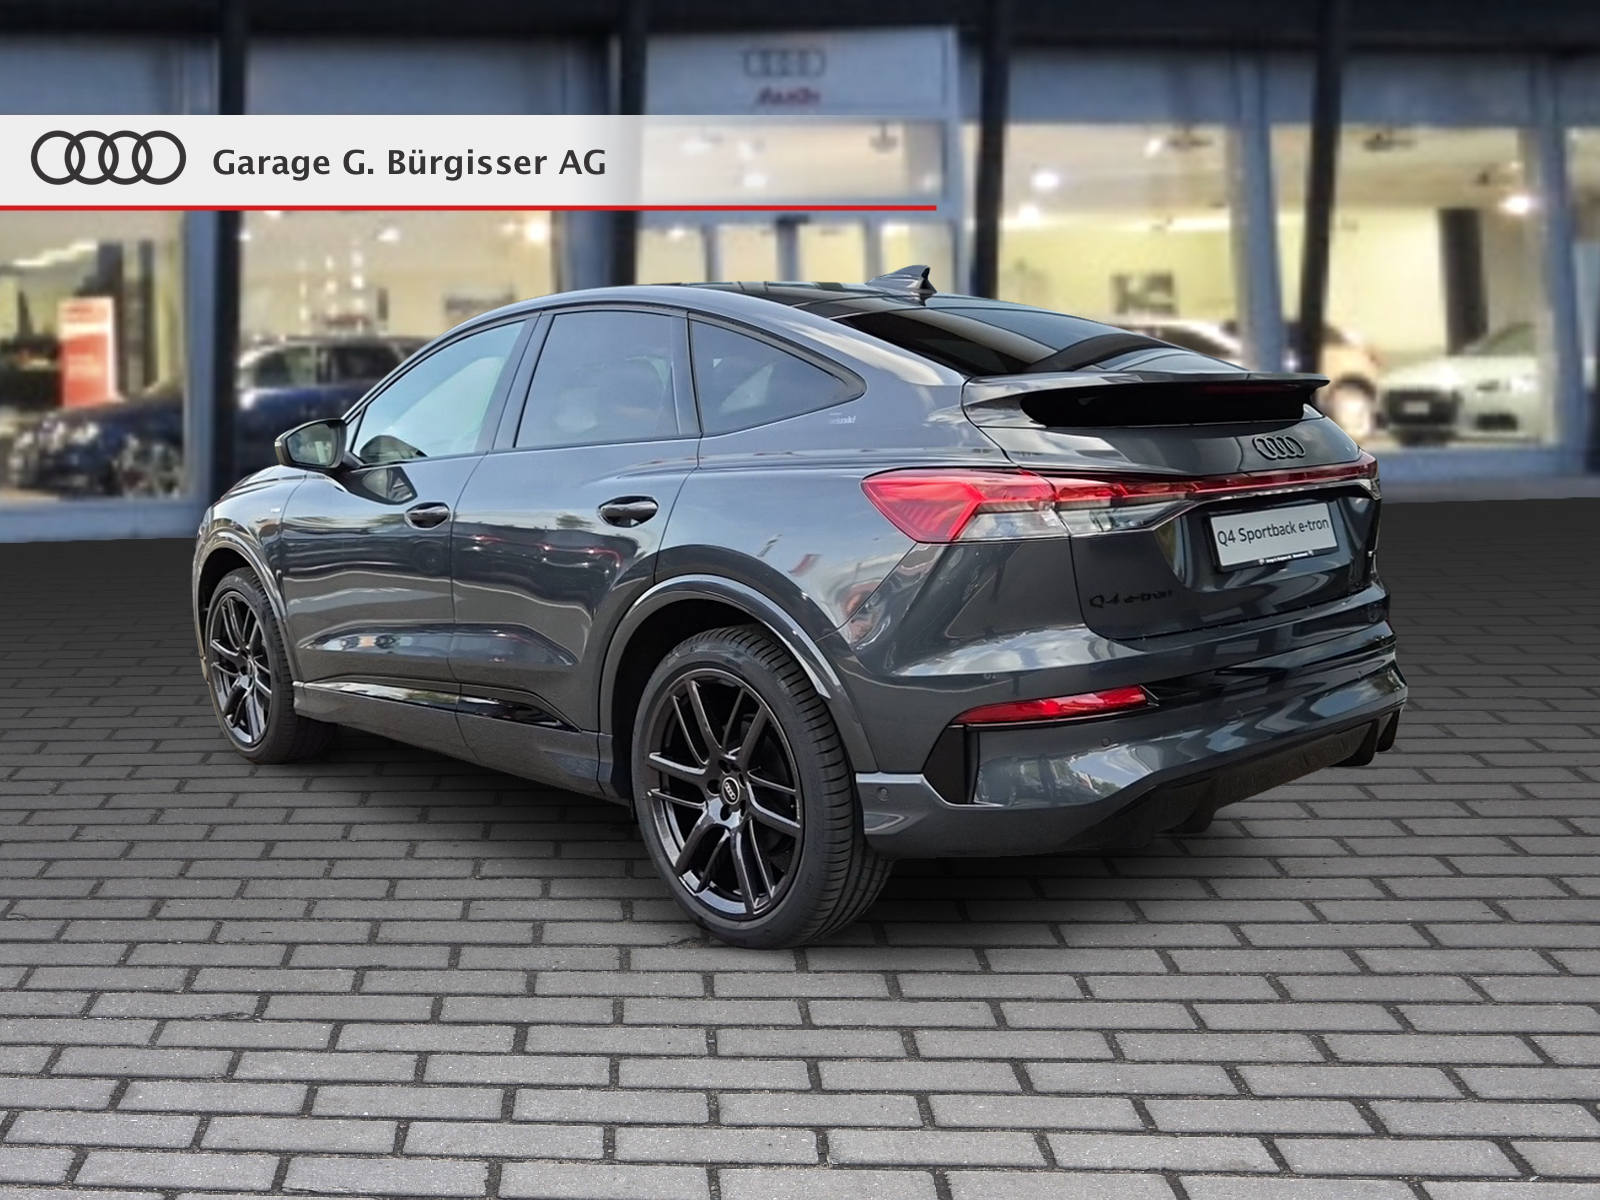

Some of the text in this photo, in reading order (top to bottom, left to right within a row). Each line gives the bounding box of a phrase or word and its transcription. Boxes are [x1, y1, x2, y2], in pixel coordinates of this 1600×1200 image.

[1217, 518, 1330, 546] Q4 Sportback e-tron
